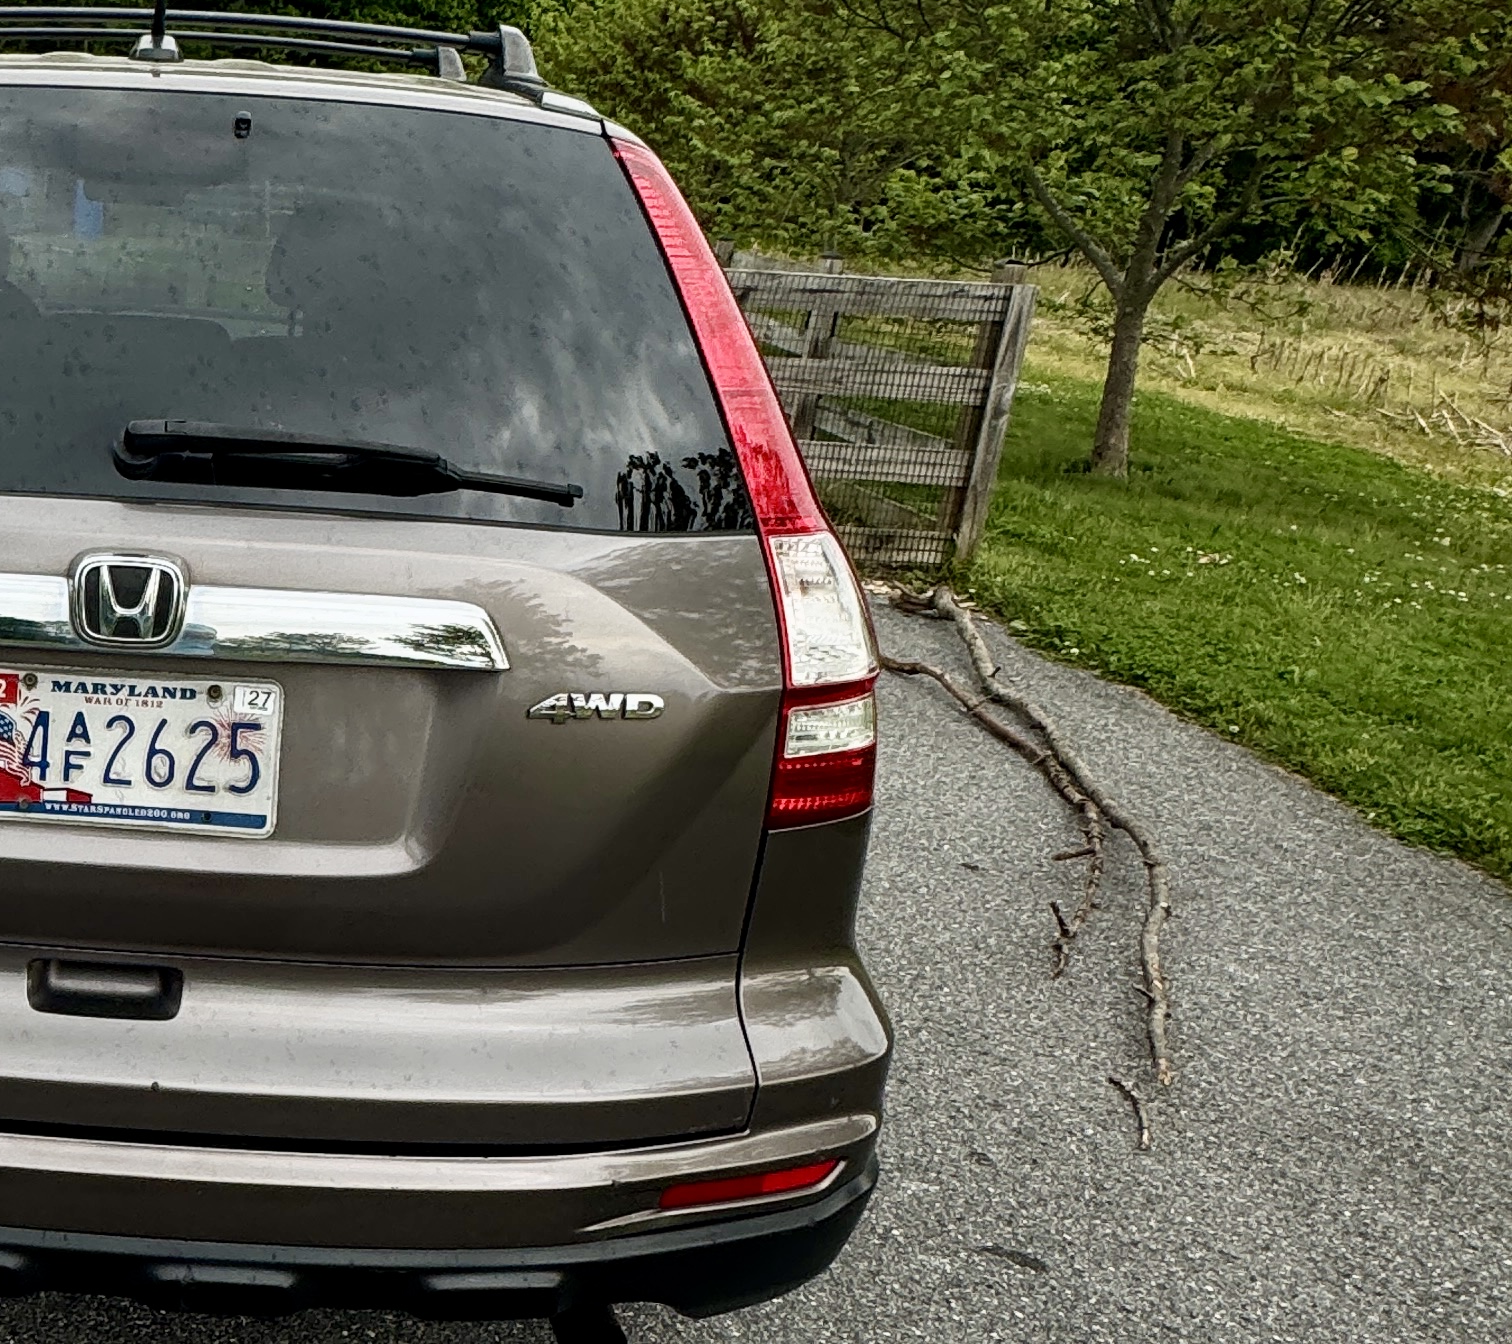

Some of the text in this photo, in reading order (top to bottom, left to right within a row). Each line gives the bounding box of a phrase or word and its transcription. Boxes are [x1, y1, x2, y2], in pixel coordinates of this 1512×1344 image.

[50, 680, 197, 701] MARYLAND
[247, 690, 273, 707] 27
[84, 696, 164, 709] WAR OF 1812
[525, 692, 665, 724] 4WD
